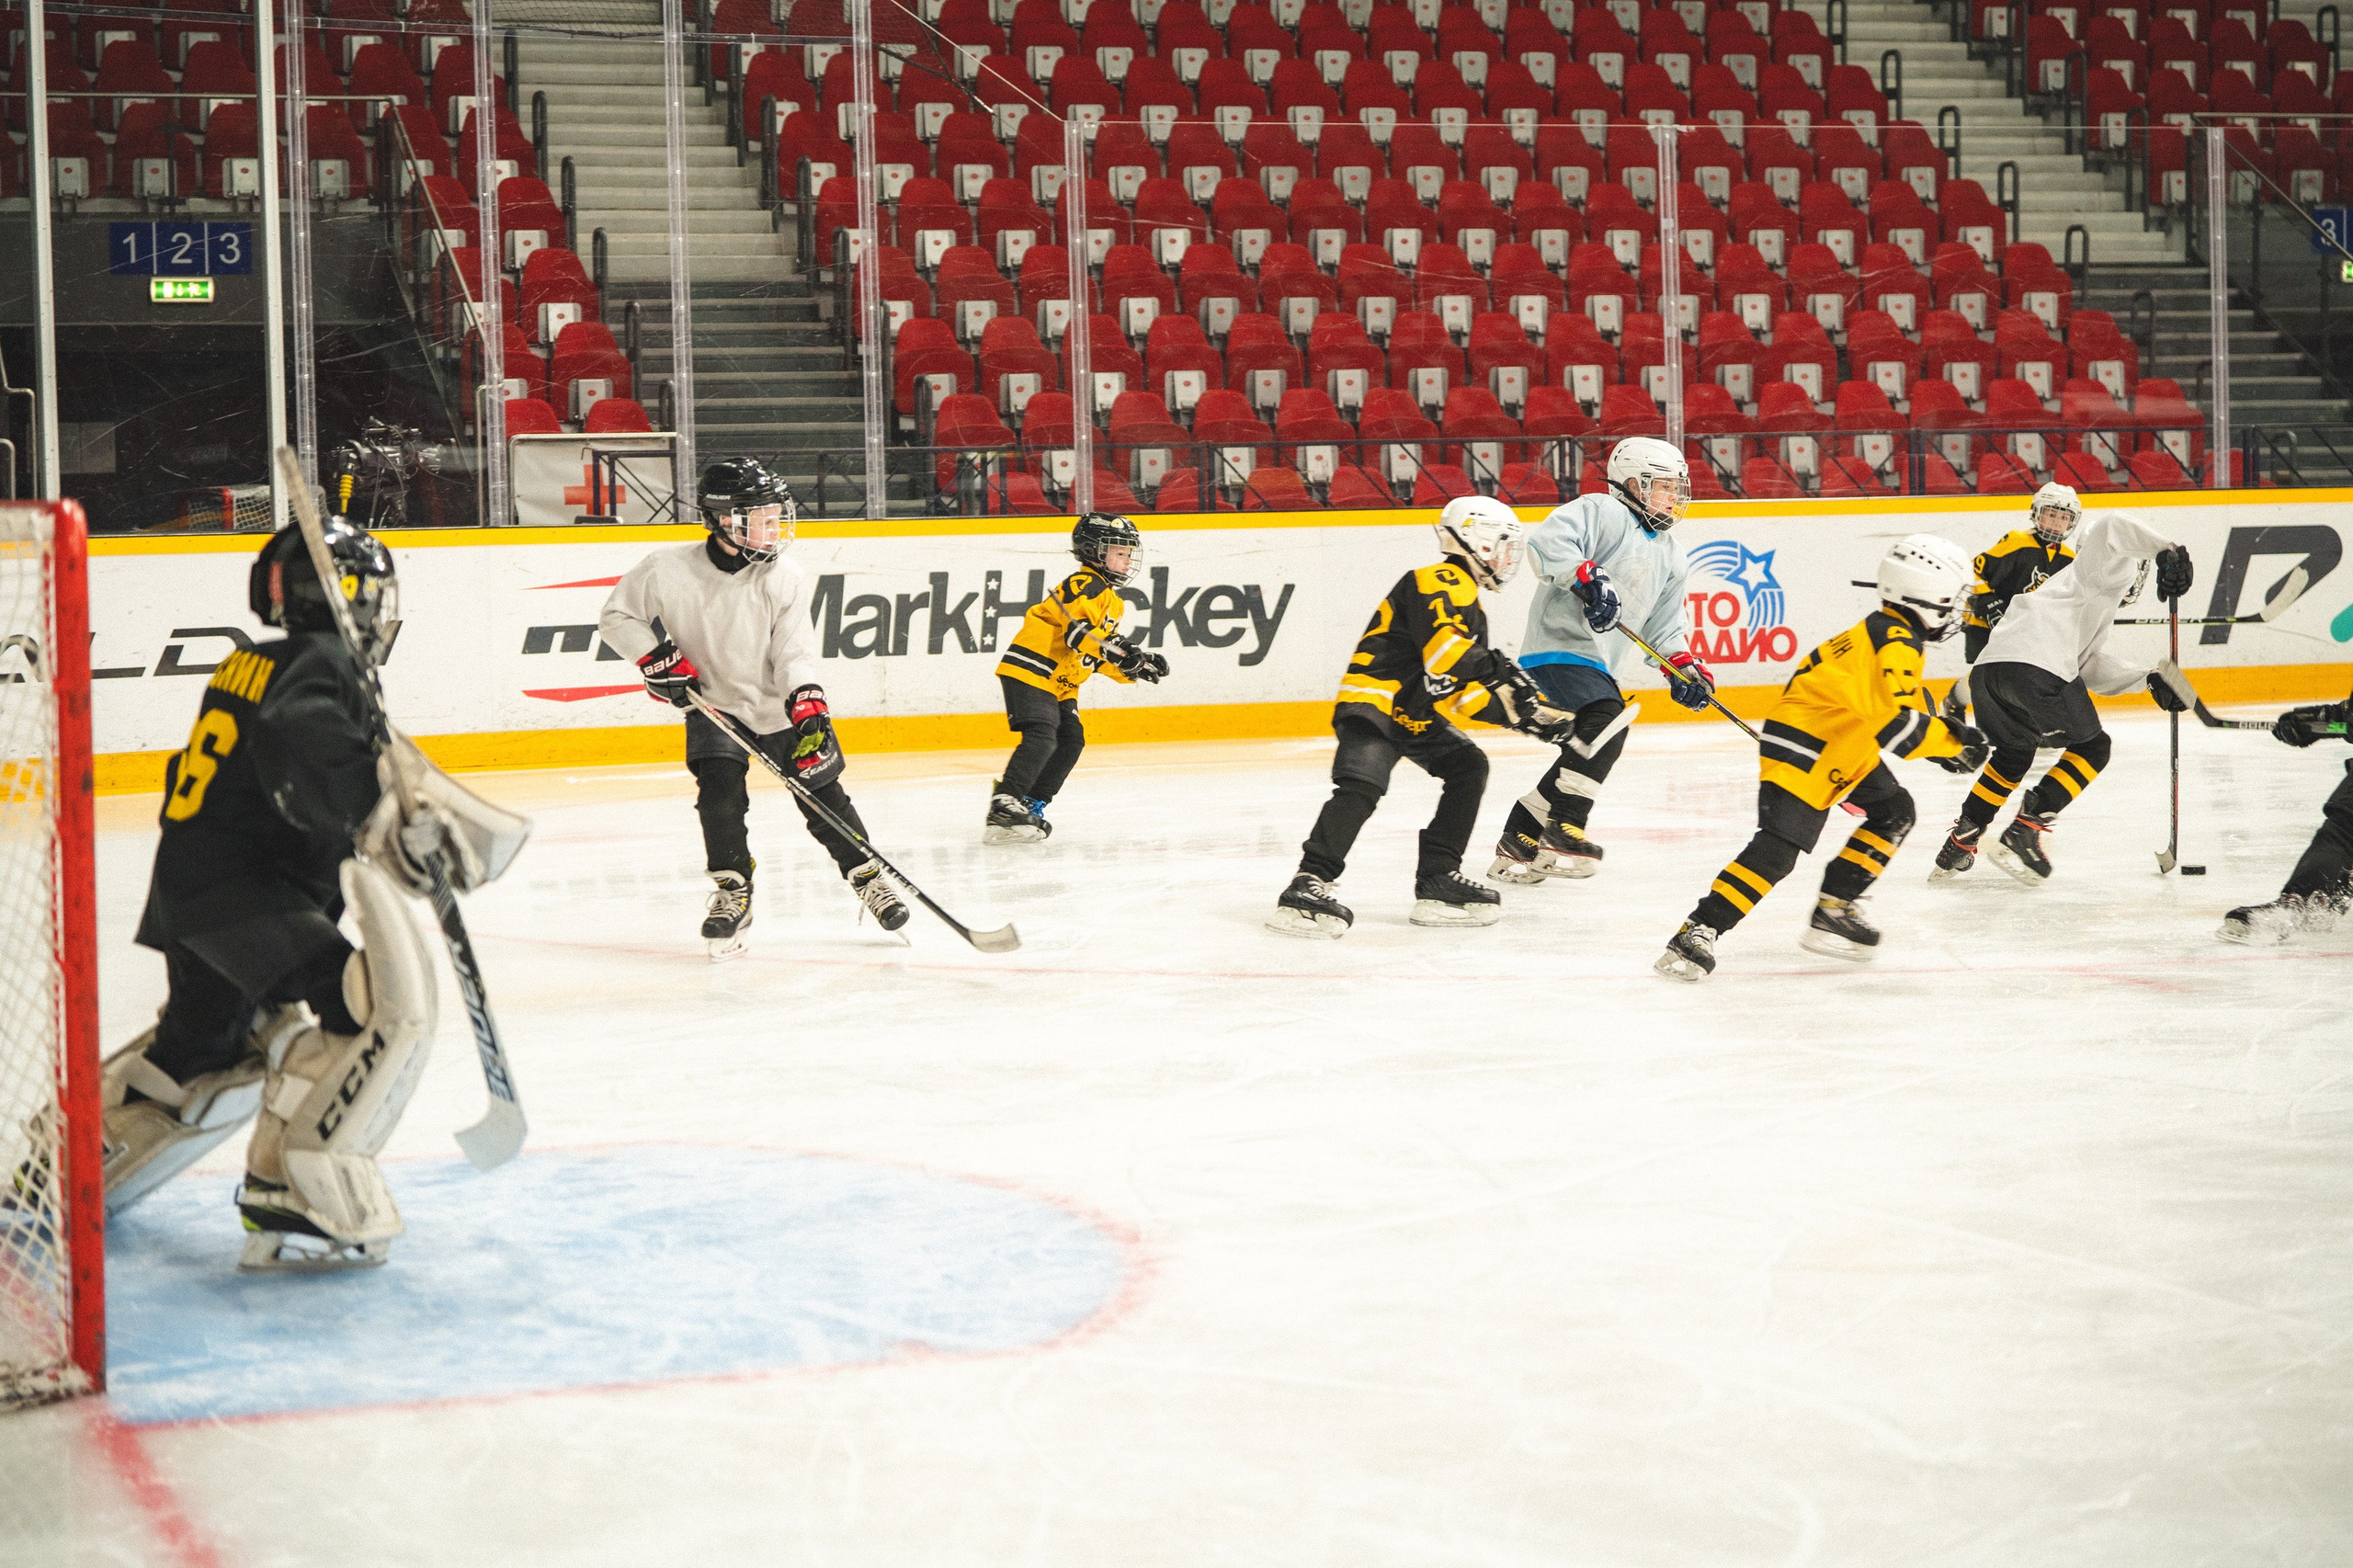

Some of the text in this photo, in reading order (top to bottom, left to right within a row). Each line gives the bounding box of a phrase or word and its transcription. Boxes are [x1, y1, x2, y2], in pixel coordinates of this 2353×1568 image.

[122, 232, 242, 265] 1 2 3
[2320, 218, 2336, 247] 3
[810, 565, 1296, 667] MarkHckey
[1684, 591, 1741, 628] ТО
[1684, 626, 1798, 665] АДИО
[317, 1028, 386, 1142] CCM
